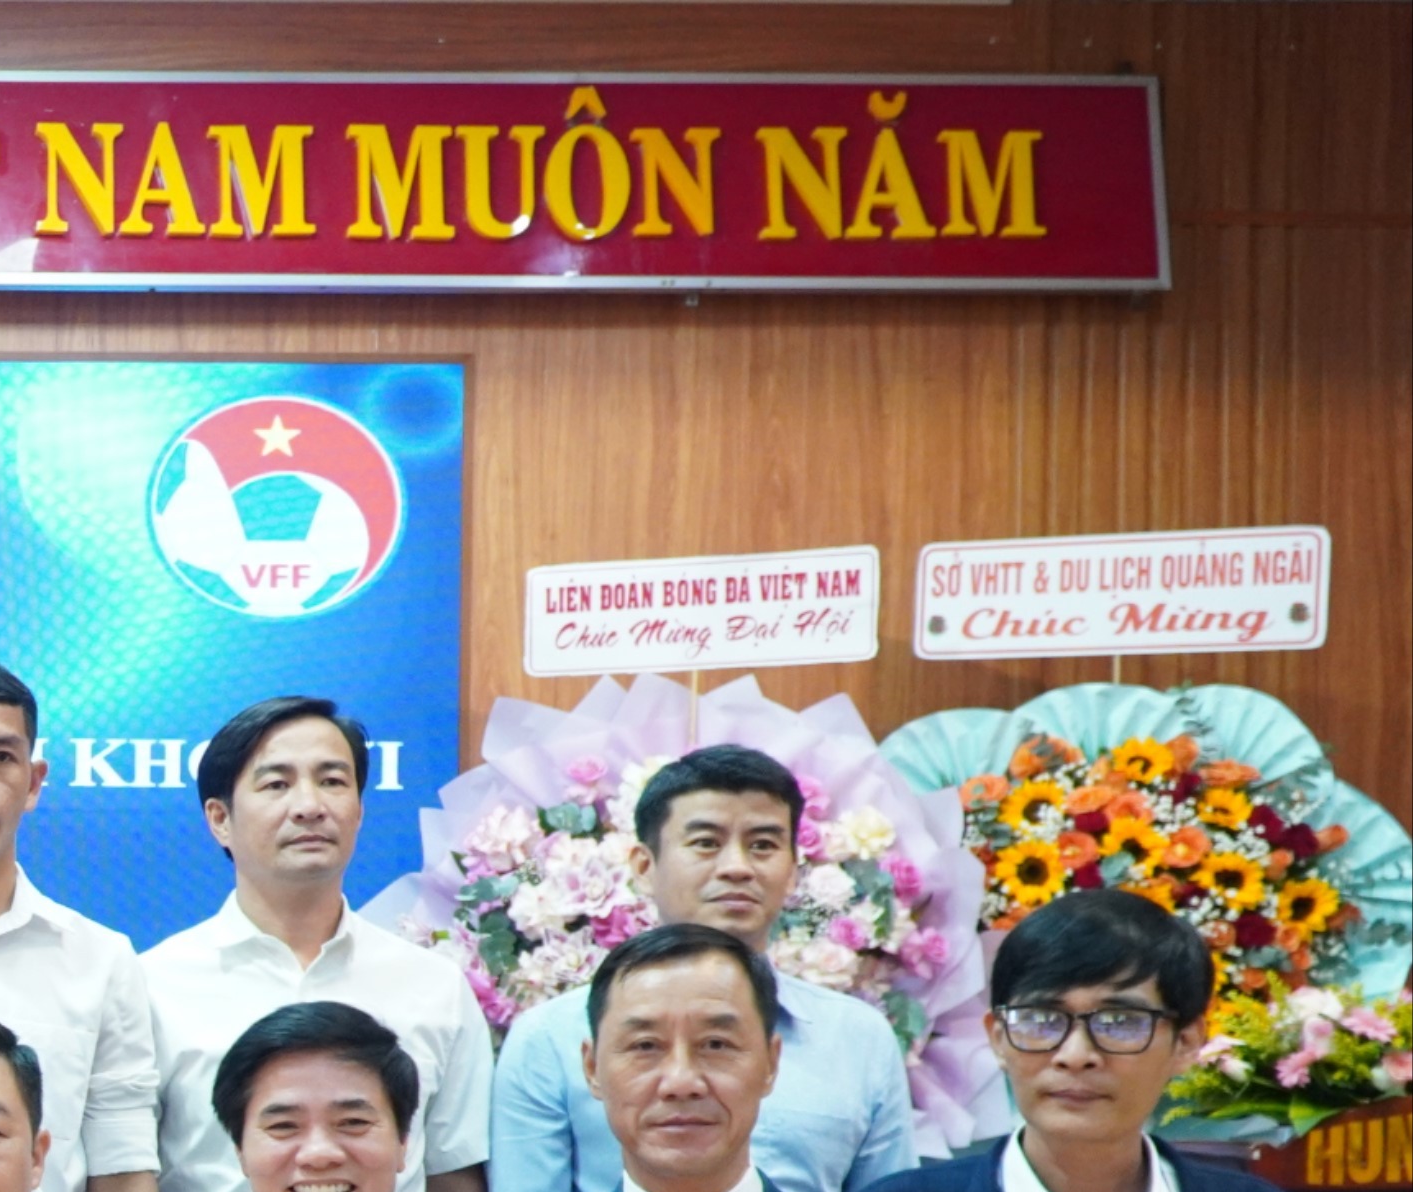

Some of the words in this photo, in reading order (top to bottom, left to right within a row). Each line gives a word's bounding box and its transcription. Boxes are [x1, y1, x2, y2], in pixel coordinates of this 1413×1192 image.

[35, 121, 316, 240] NAM
[345, 85, 721, 240] MUÔN
[755, 90, 1047, 240] NĂM
[241, 563, 311, 589] VFF
[816, 568, 862, 599] NAM
[970, 561, 1025, 596] VHTT
[1034, 561, 1049, 594] &
[1060, 558, 1091, 593] DU
[1099, 556, 1151, 599] LỊCH
[1160, 542, 1243, 592] QUẢNG
[1254, 542, 1313, 586] NGÃI
[555, 621, 620, 650] Chúc
[961, 607, 1087, 640] Chúc
[1109, 602, 1271, 643] Mừng
